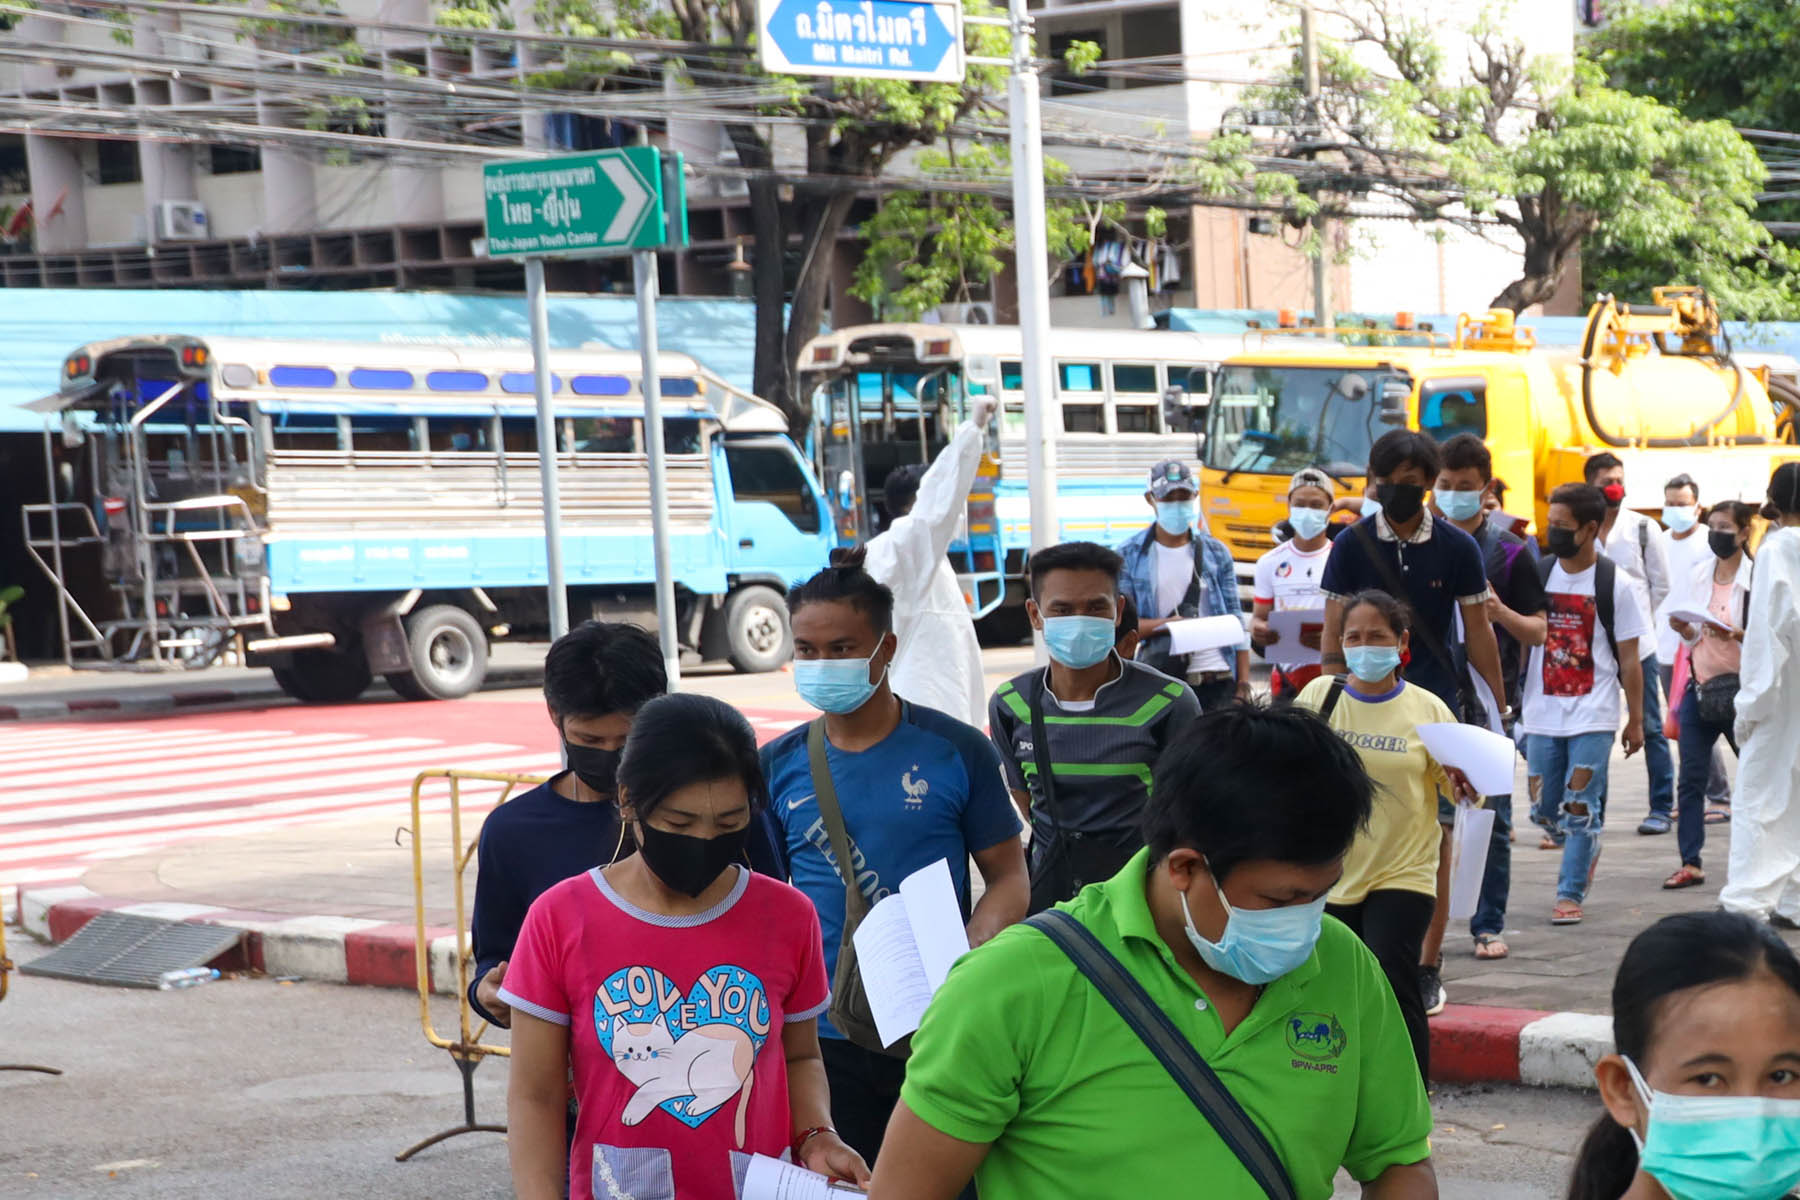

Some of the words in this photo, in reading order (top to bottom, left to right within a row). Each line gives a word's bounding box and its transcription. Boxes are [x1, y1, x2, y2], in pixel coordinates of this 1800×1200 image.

[796, 1, 927, 46] ถ.มิตรไมตรี
[812, 44, 836, 62] Mit
[841, 45, 883, 65] Maitri
[541, 233, 567, 247] Youth
[596, 965, 699, 1031] LOVE
[697, 972, 772, 1036] YOU
